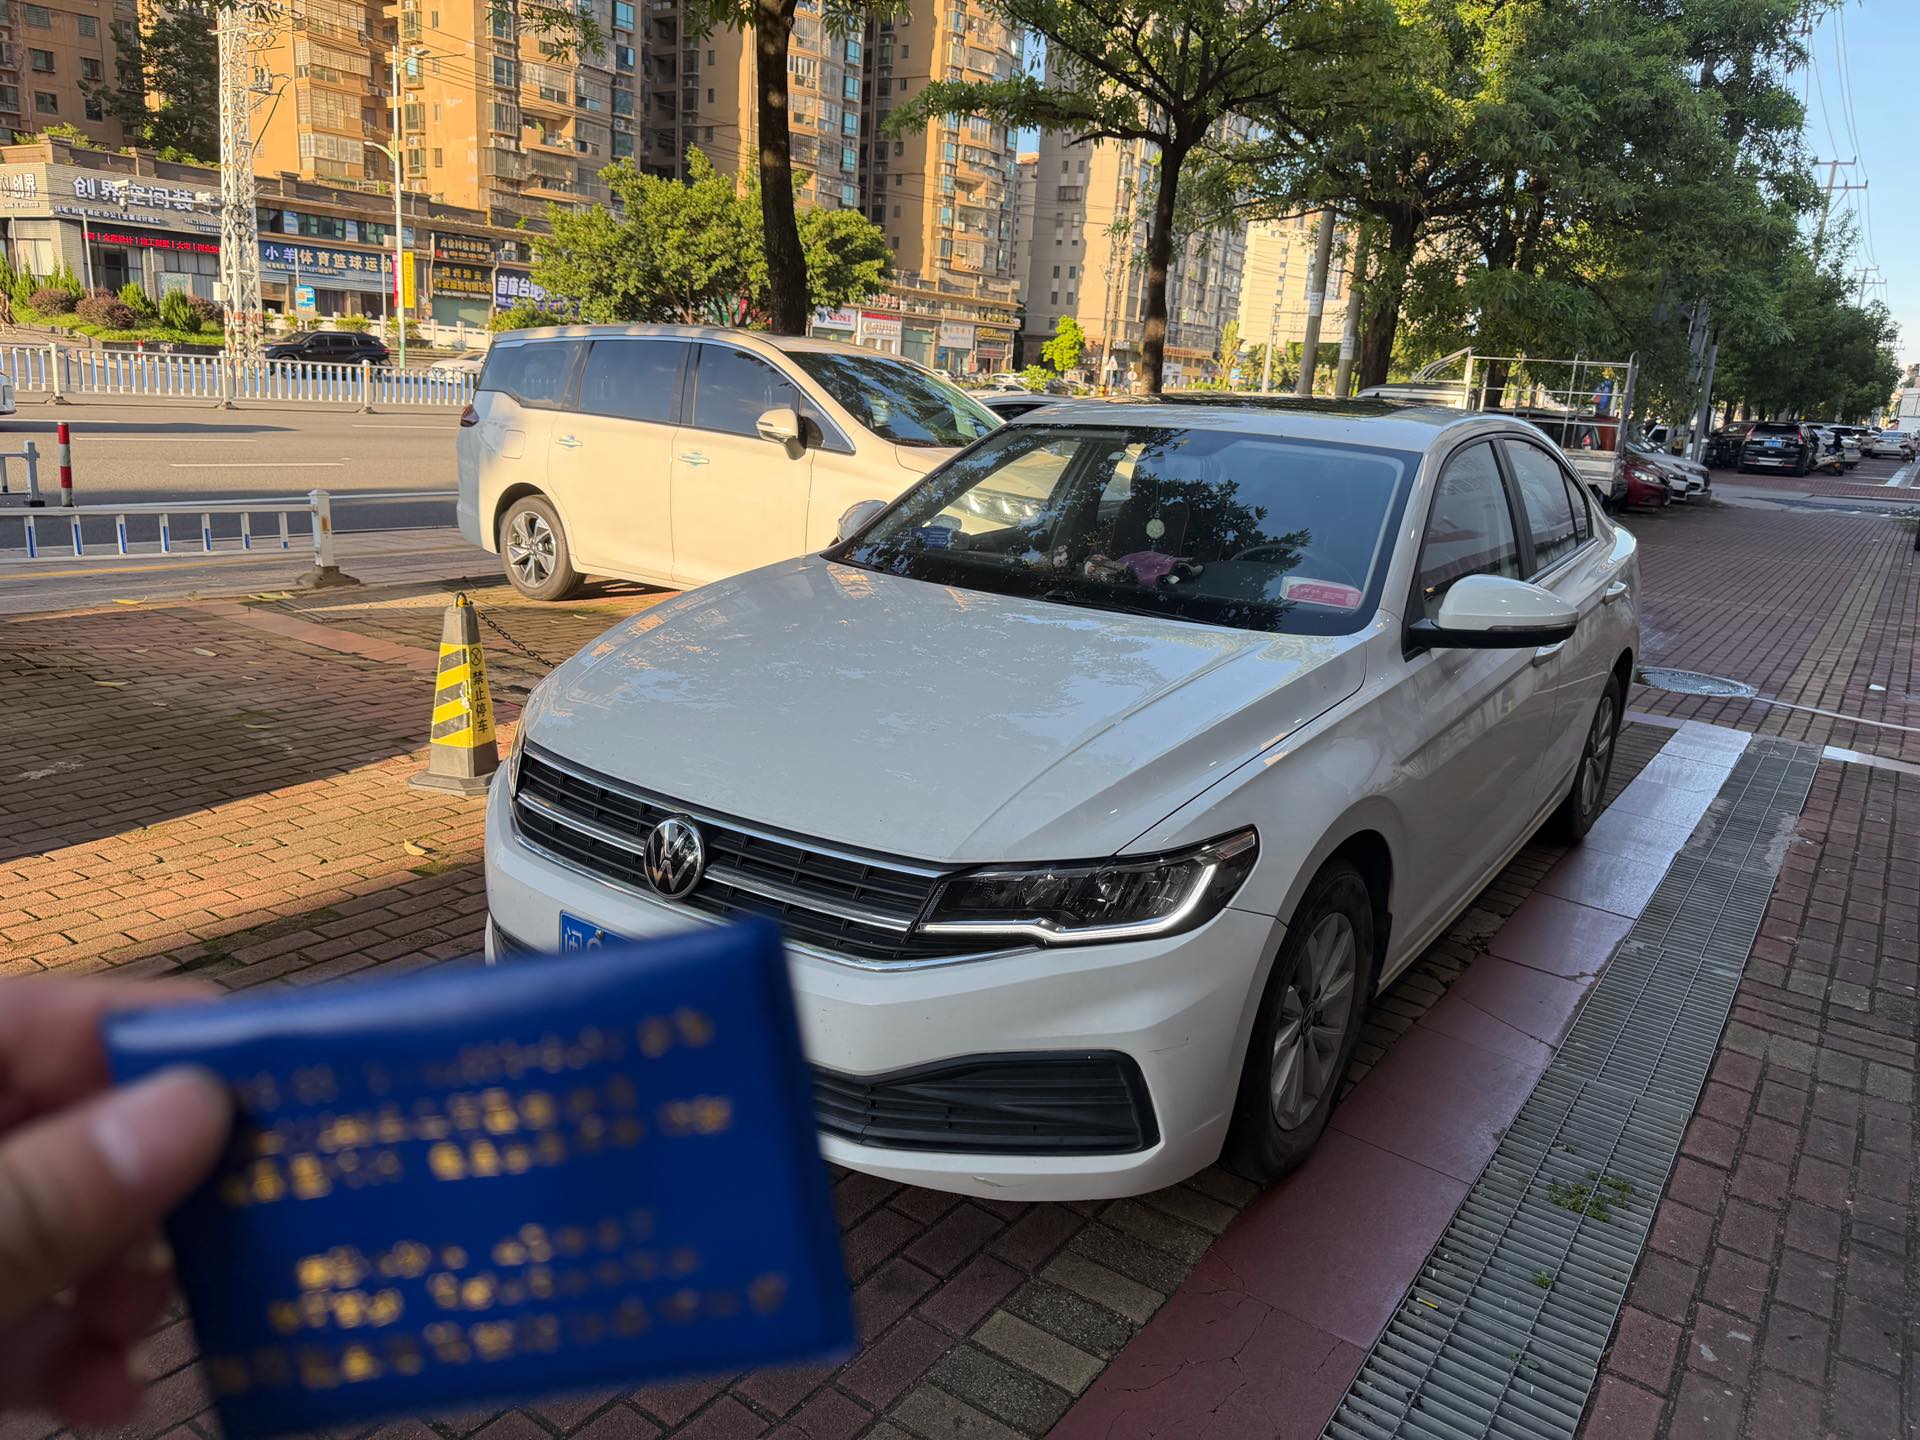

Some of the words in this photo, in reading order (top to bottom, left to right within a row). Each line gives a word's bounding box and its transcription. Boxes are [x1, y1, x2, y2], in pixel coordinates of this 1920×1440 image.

[72, 176, 212, 212] 创界空间装
[472, 670, 489, 734] 禁止停车
